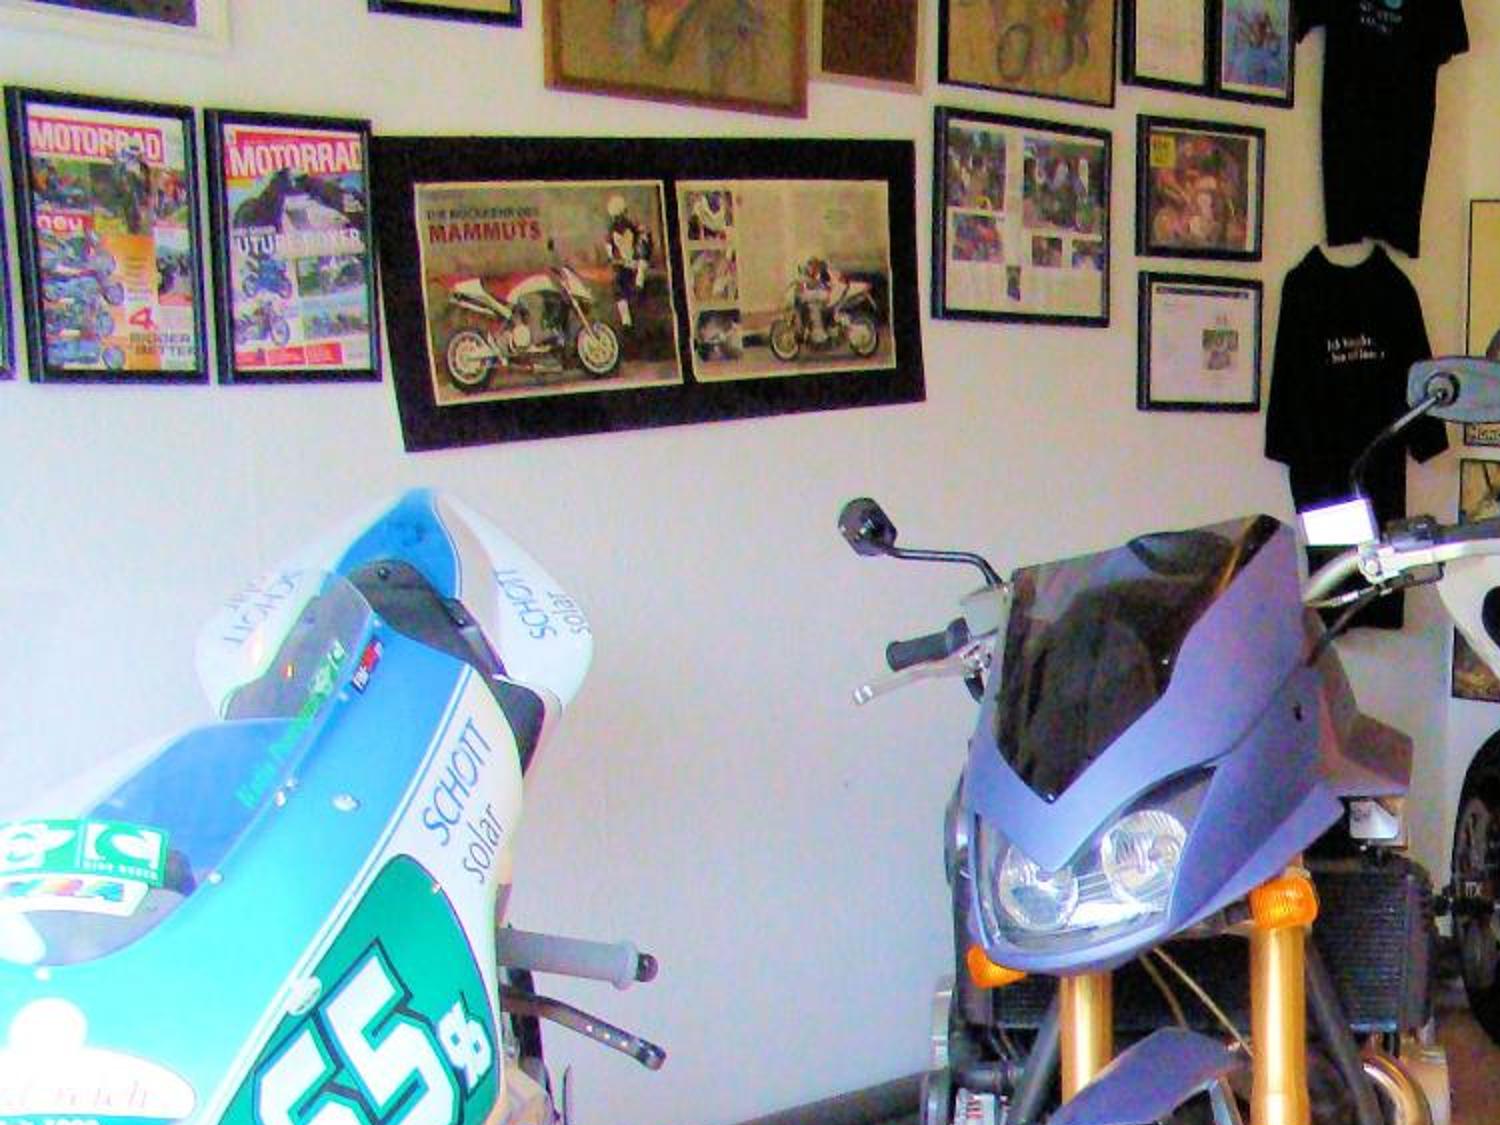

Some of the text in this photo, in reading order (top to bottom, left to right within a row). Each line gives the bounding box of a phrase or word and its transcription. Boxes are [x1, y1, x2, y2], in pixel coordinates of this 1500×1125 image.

[428, 220, 542, 245] MAMMUTS
[422, 714, 492, 847] SCHOTT
[462, 802, 505, 885] solar
